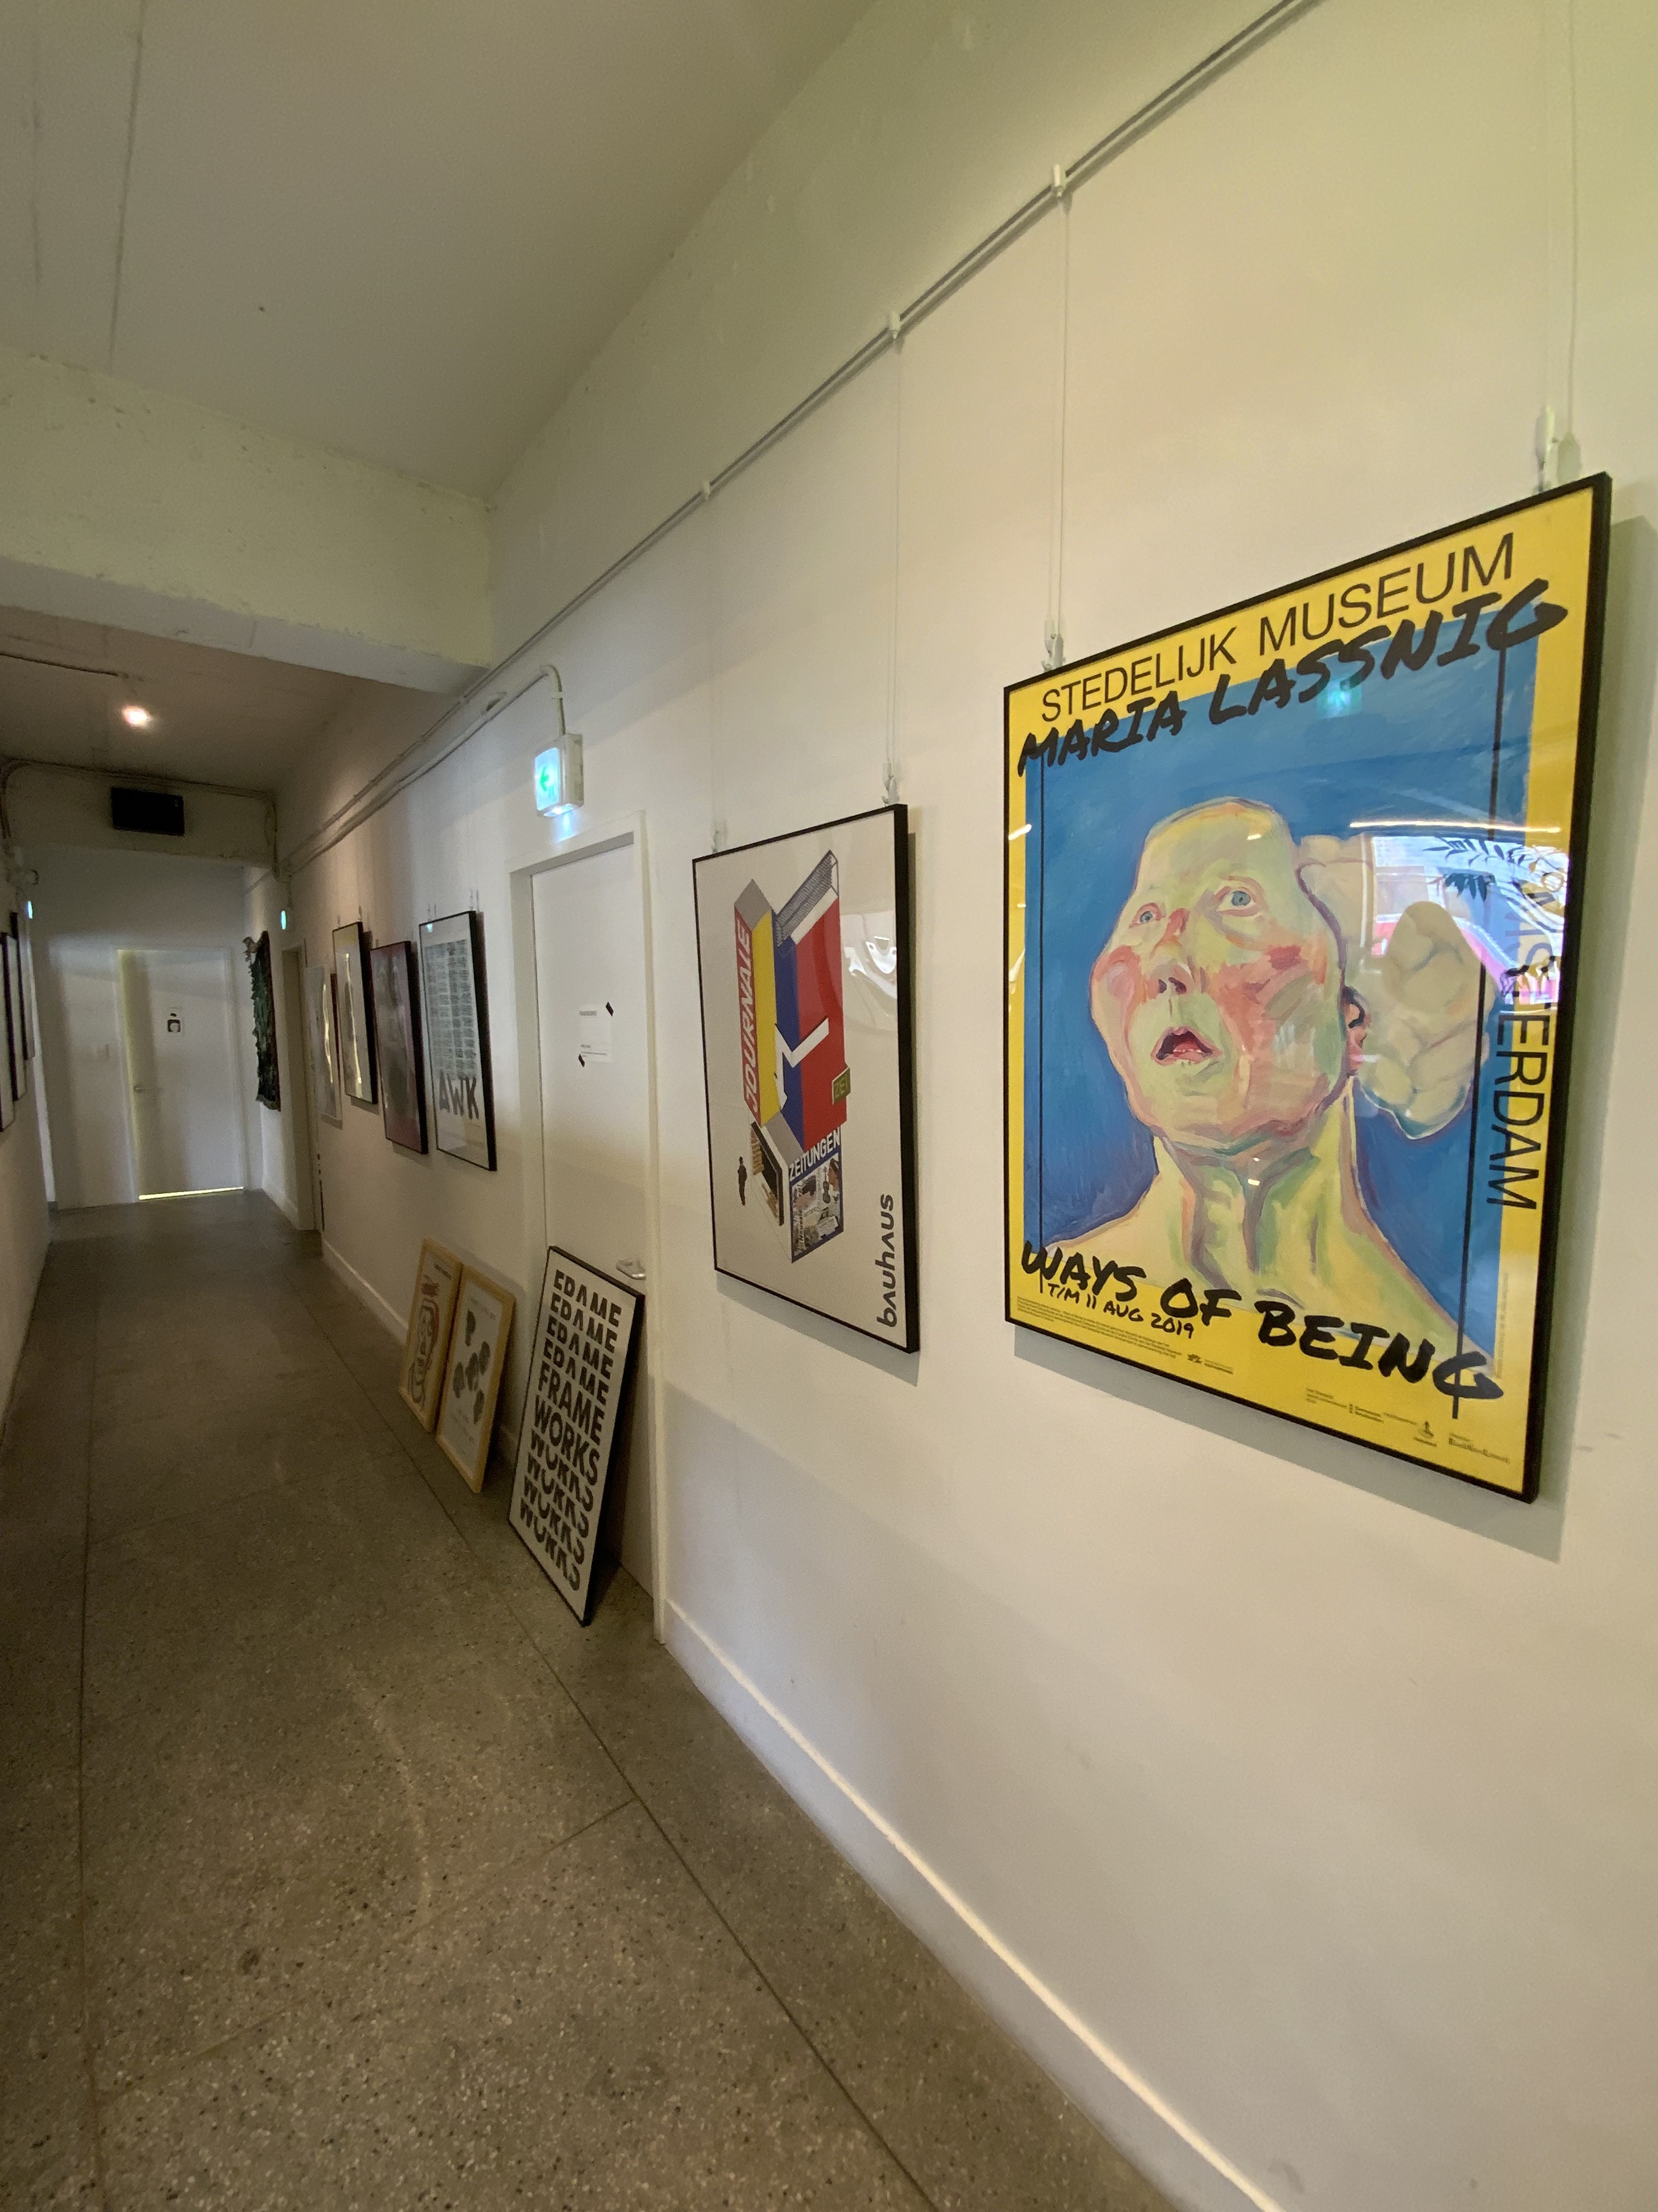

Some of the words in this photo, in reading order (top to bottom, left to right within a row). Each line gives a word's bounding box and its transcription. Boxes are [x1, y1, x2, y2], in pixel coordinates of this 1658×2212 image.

[1017, 691, 1187, 776] MARIA
[1208, 578, 1567, 726] LASSNIG
[1042, 626, 1237, 722] STEDELIJK
[1259, 533, 1514, 656] MUSEUM
[789, 1126, 841, 1180] ZEITUNGEN
[875, 1194, 898, 1328] bauhaus
[1048, 1283, 1080, 1304] T/M
[1086, 1295, 1097, 1310] 11
[1103, 1300, 1144, 1322] AUG
[1151, 1312, 1194, 1339] 2019
[1021, 1240, 1147, 1302] WAYS
[1160, 1278, 1242, 1326] OF
[1254, 1300, 1504, 1400] BEING
[534, 1395, 600, 1485] WORKS
[538, 1360, 605, 1446] FRAME
